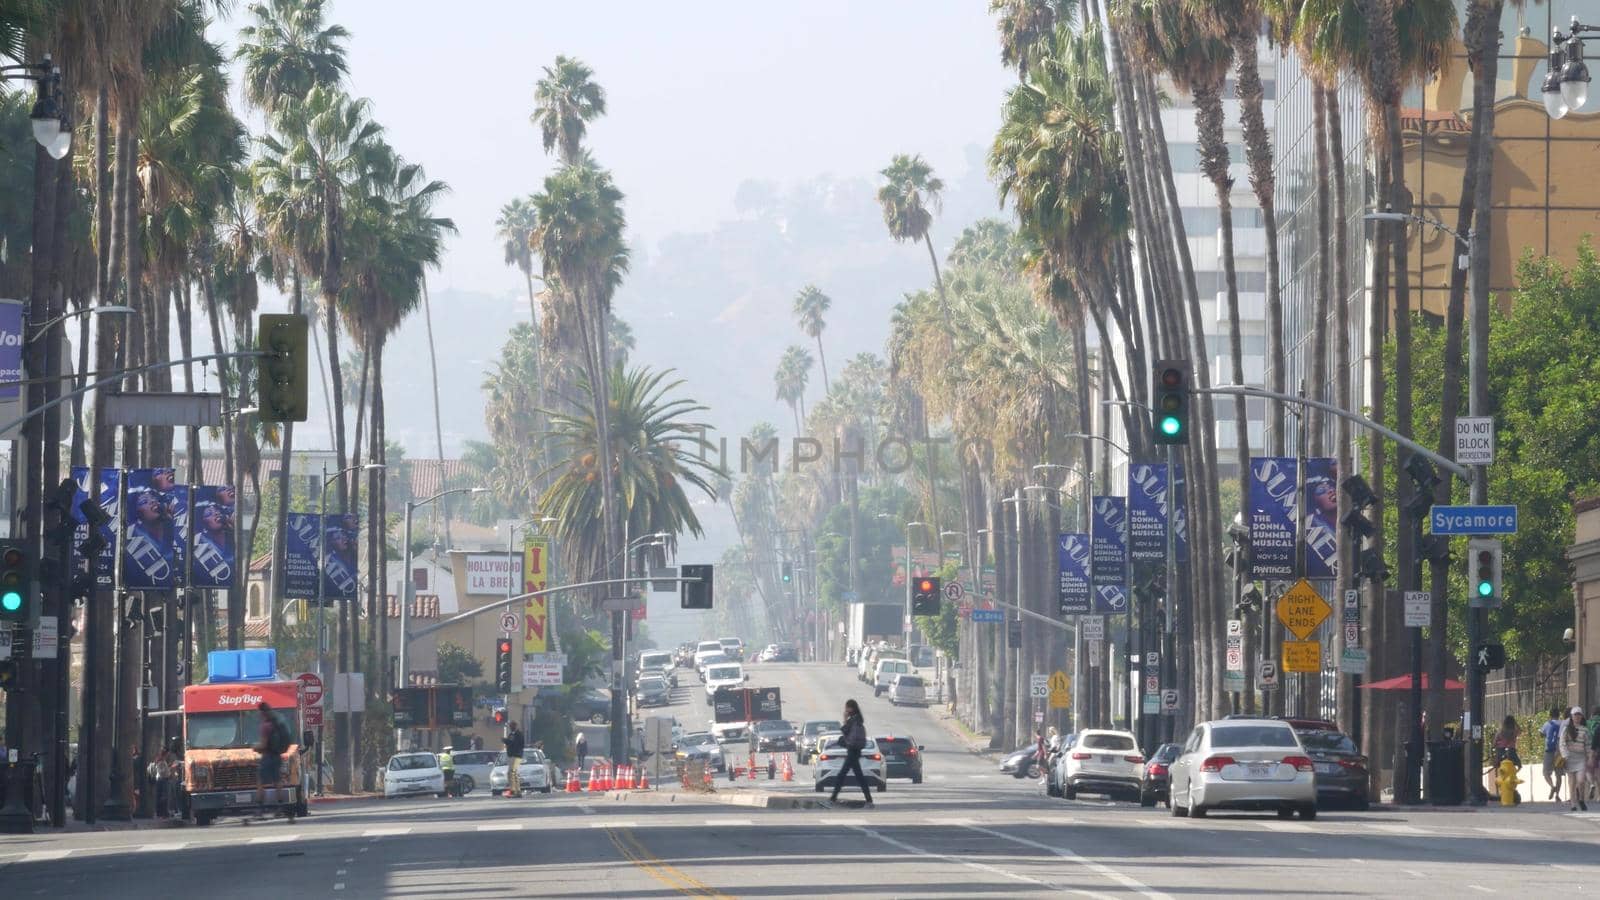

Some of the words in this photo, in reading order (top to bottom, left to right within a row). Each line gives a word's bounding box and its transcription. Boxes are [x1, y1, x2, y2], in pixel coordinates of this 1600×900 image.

[1457, 423, 1470, 434] DO
[1473, 423, 1491, 434] NOT
[1458, 438, 1490, 449] BLOCK
[1458, 451, 1491, 459] INTERSECTION
[1435, 513, 1514, 530] Sycamore
[1252, 531, 1292, 539] SUMMER
[467, 561, 520, 572] HOLLYWOOD
[1252, 565, 1292, 577] PANTAGES
[472, 577, 485, 588] LA
[490, 577, 515, 588] BREA
[1287, 594, 1316, 604] RIGHT
[1406, 593, 1430, 601] LAPD
[1289, 607, 1315, 616] LANE
[1289, 618, 1316, 627] ENDS
[1033, 687, 1047, 695] 30
[218, 694, 263, 706] StopBye
